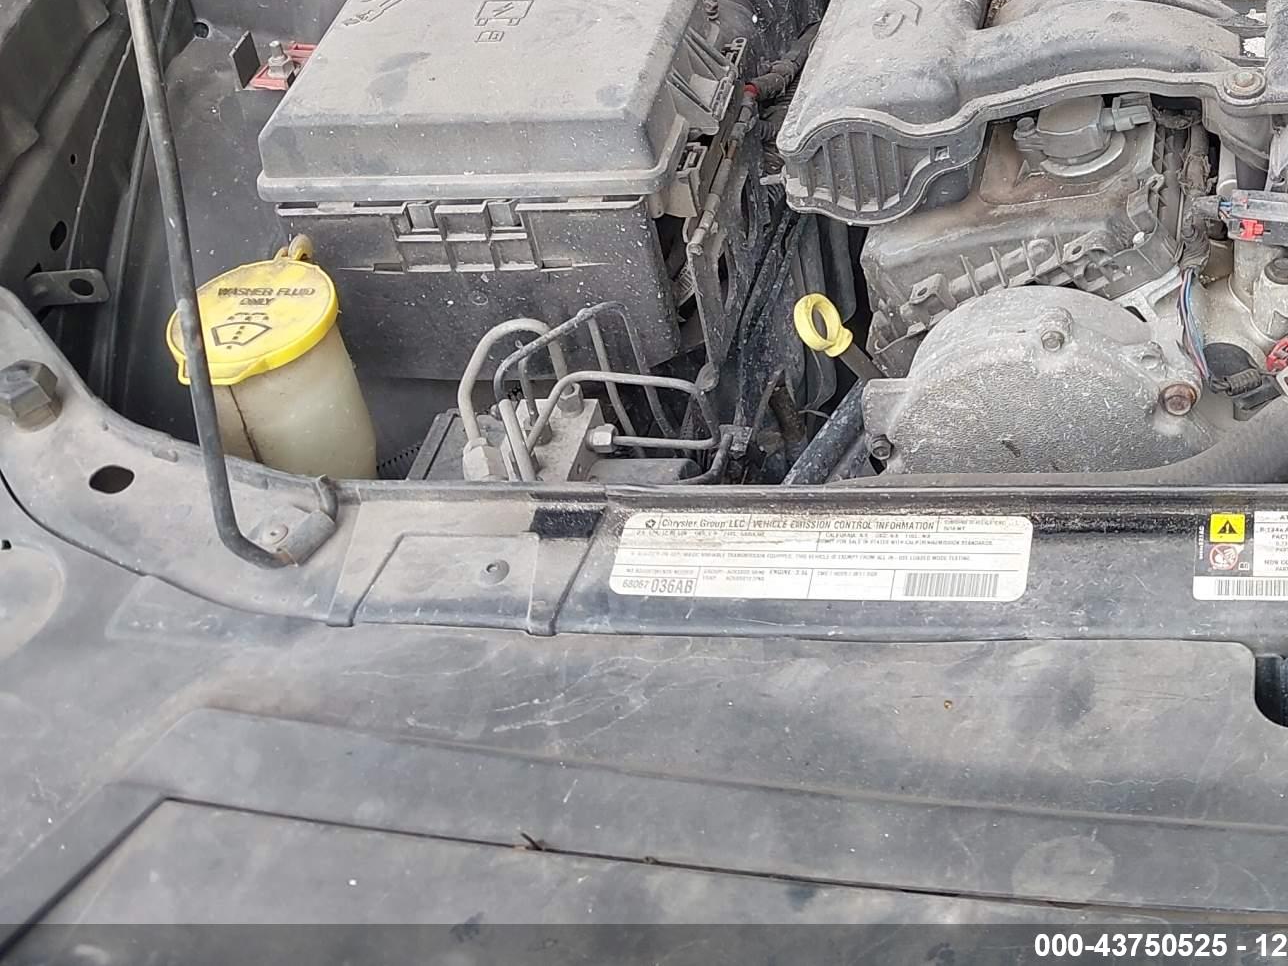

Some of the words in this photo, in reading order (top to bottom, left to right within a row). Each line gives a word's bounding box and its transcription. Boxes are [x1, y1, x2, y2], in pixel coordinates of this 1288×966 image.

[218, 287, 274, 296] WASHER
[276, 288, 316, 296] FLUID
[239, 297, 275, 306] ONLY
[662, 518, 695, 529] Chrysler
[700, 519, 726, 529] Group
[729, 519, 745, 528] LLC
[753, 520, 787, 529] VEHICLE
[791, 520, 831, 529] EMISSION
[834, 520, 872, 530] CONTROL
[875, 521, 934, 531] INFORMATION
[651, 579, 693, 594] 036AB
